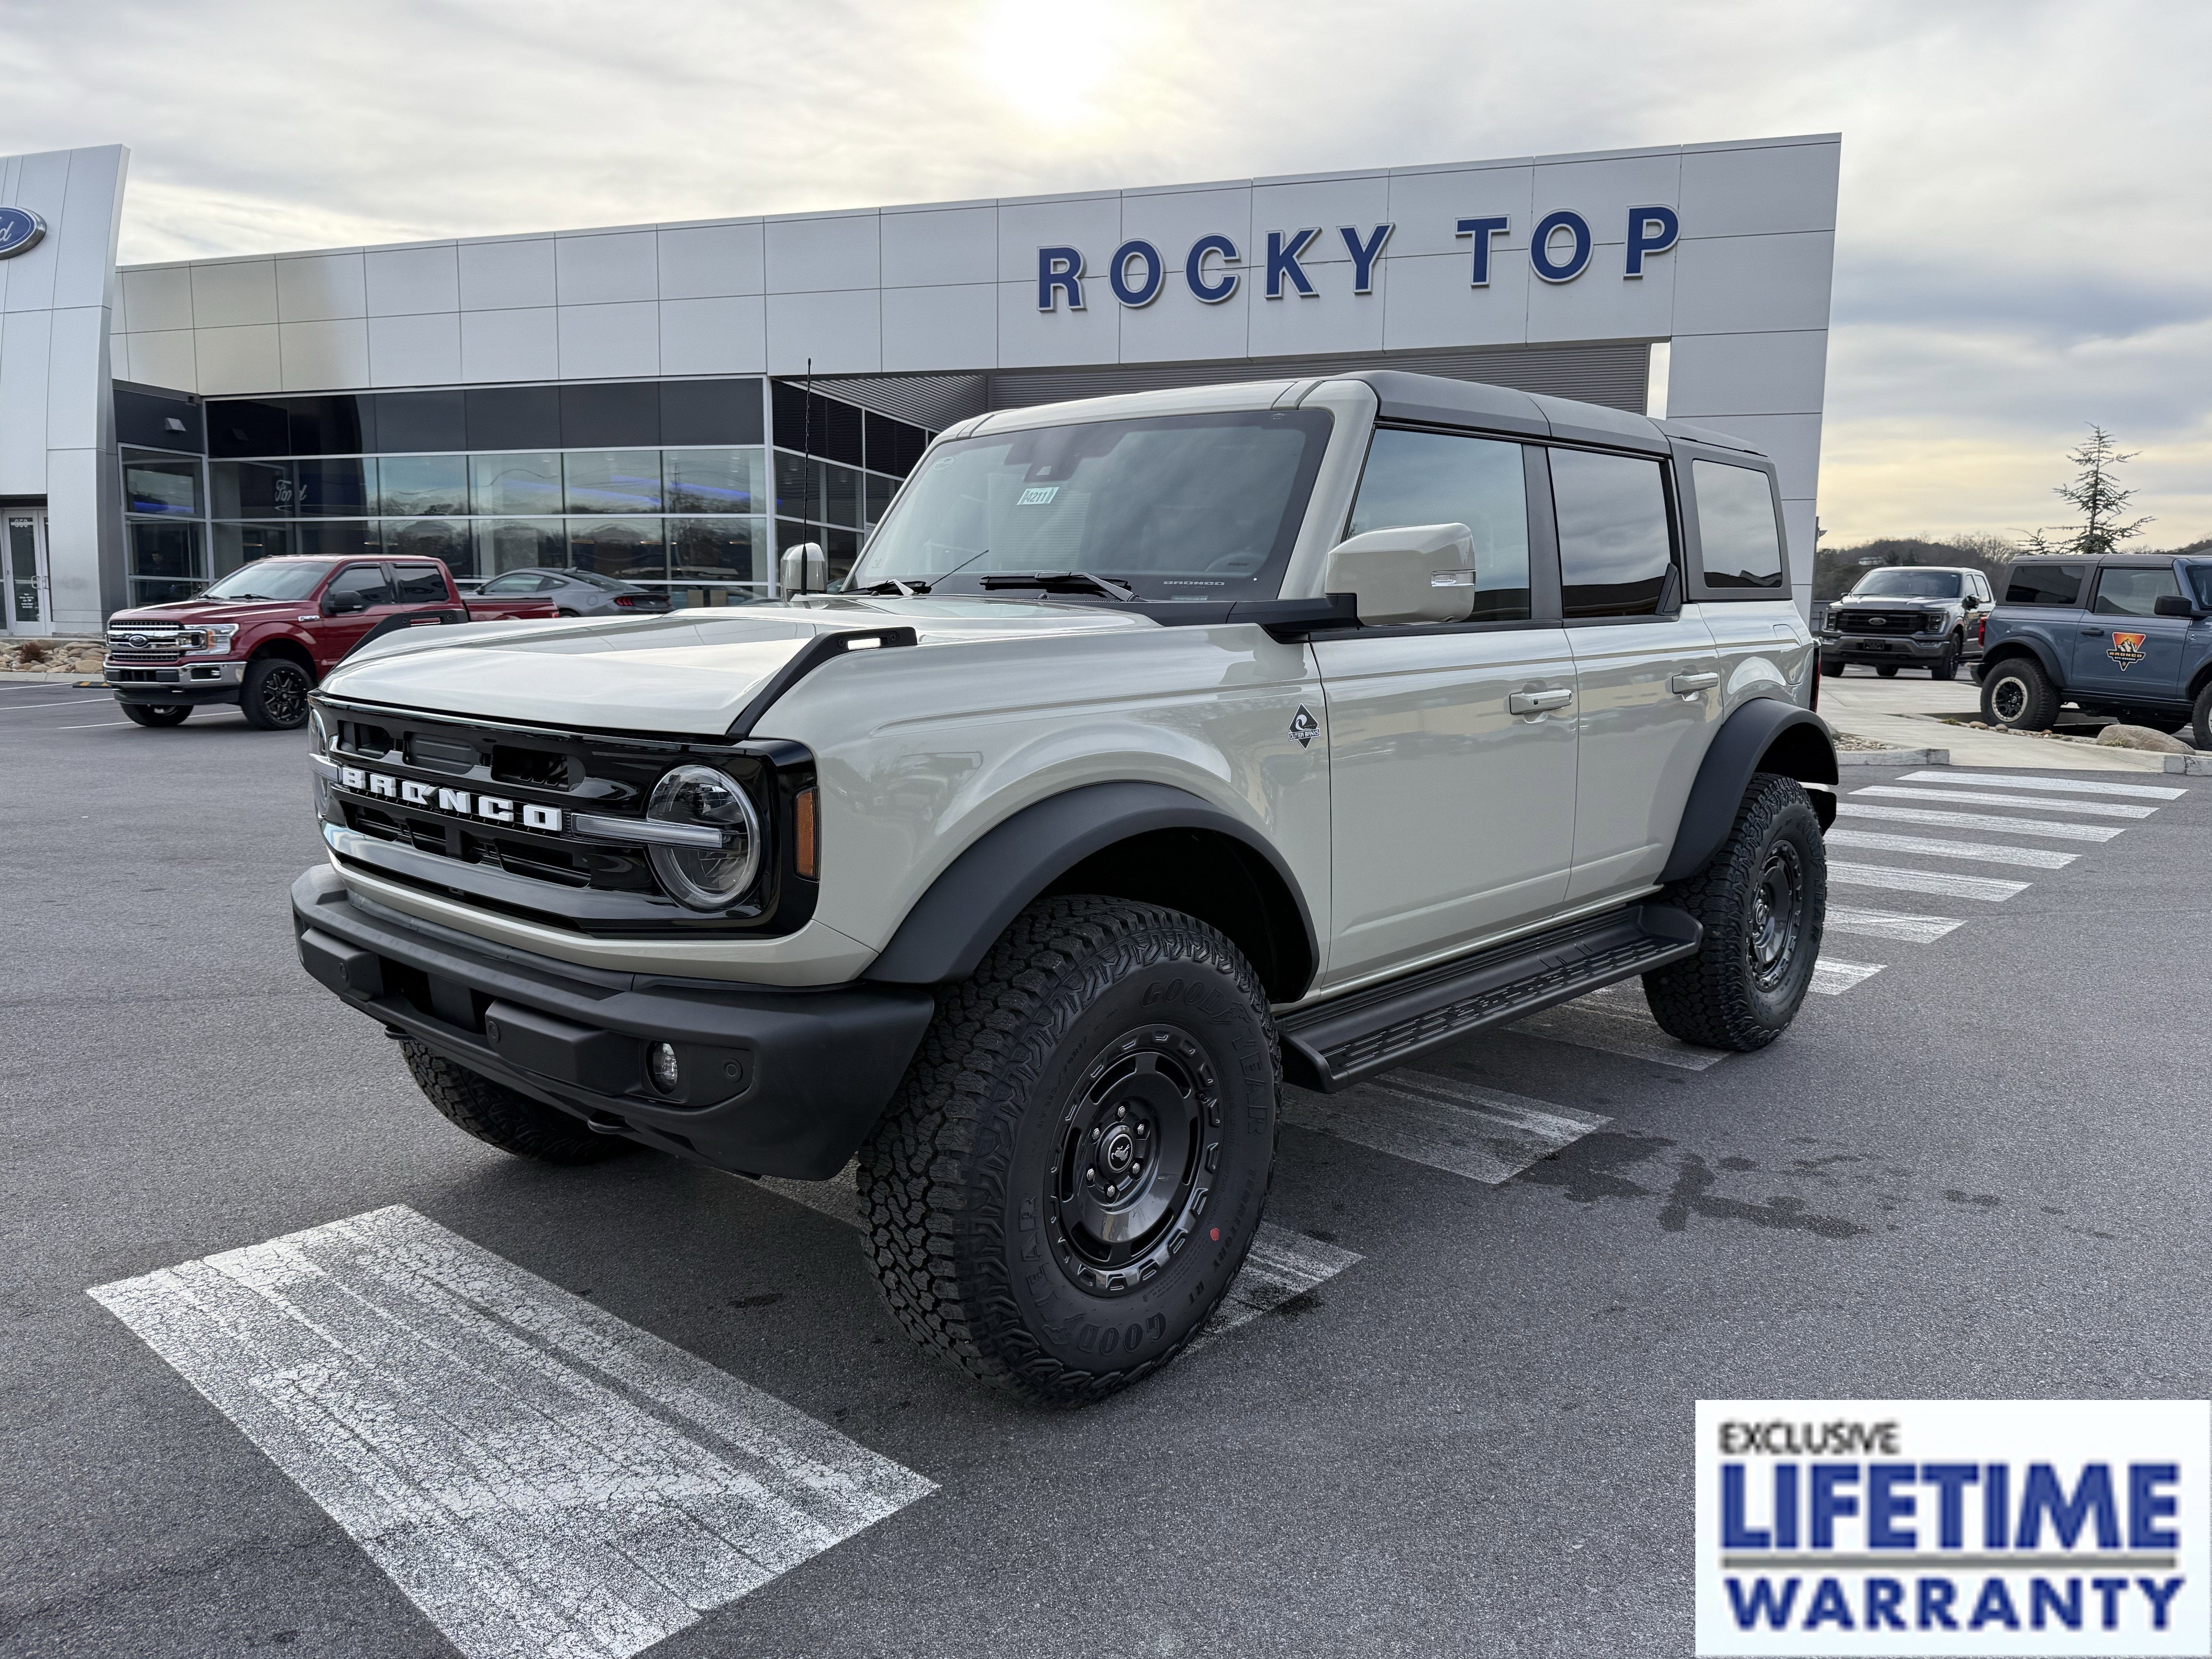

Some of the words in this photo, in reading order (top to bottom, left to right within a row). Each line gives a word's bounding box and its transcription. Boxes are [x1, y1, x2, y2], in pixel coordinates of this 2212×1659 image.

[1037, 222, 1395, 312] ROCKY
[1455, 204, 1681, 287] TOP
[342, 767, 563, 832] BRONCO
[1141, 977, 1268, 1134] GOODYEAR
